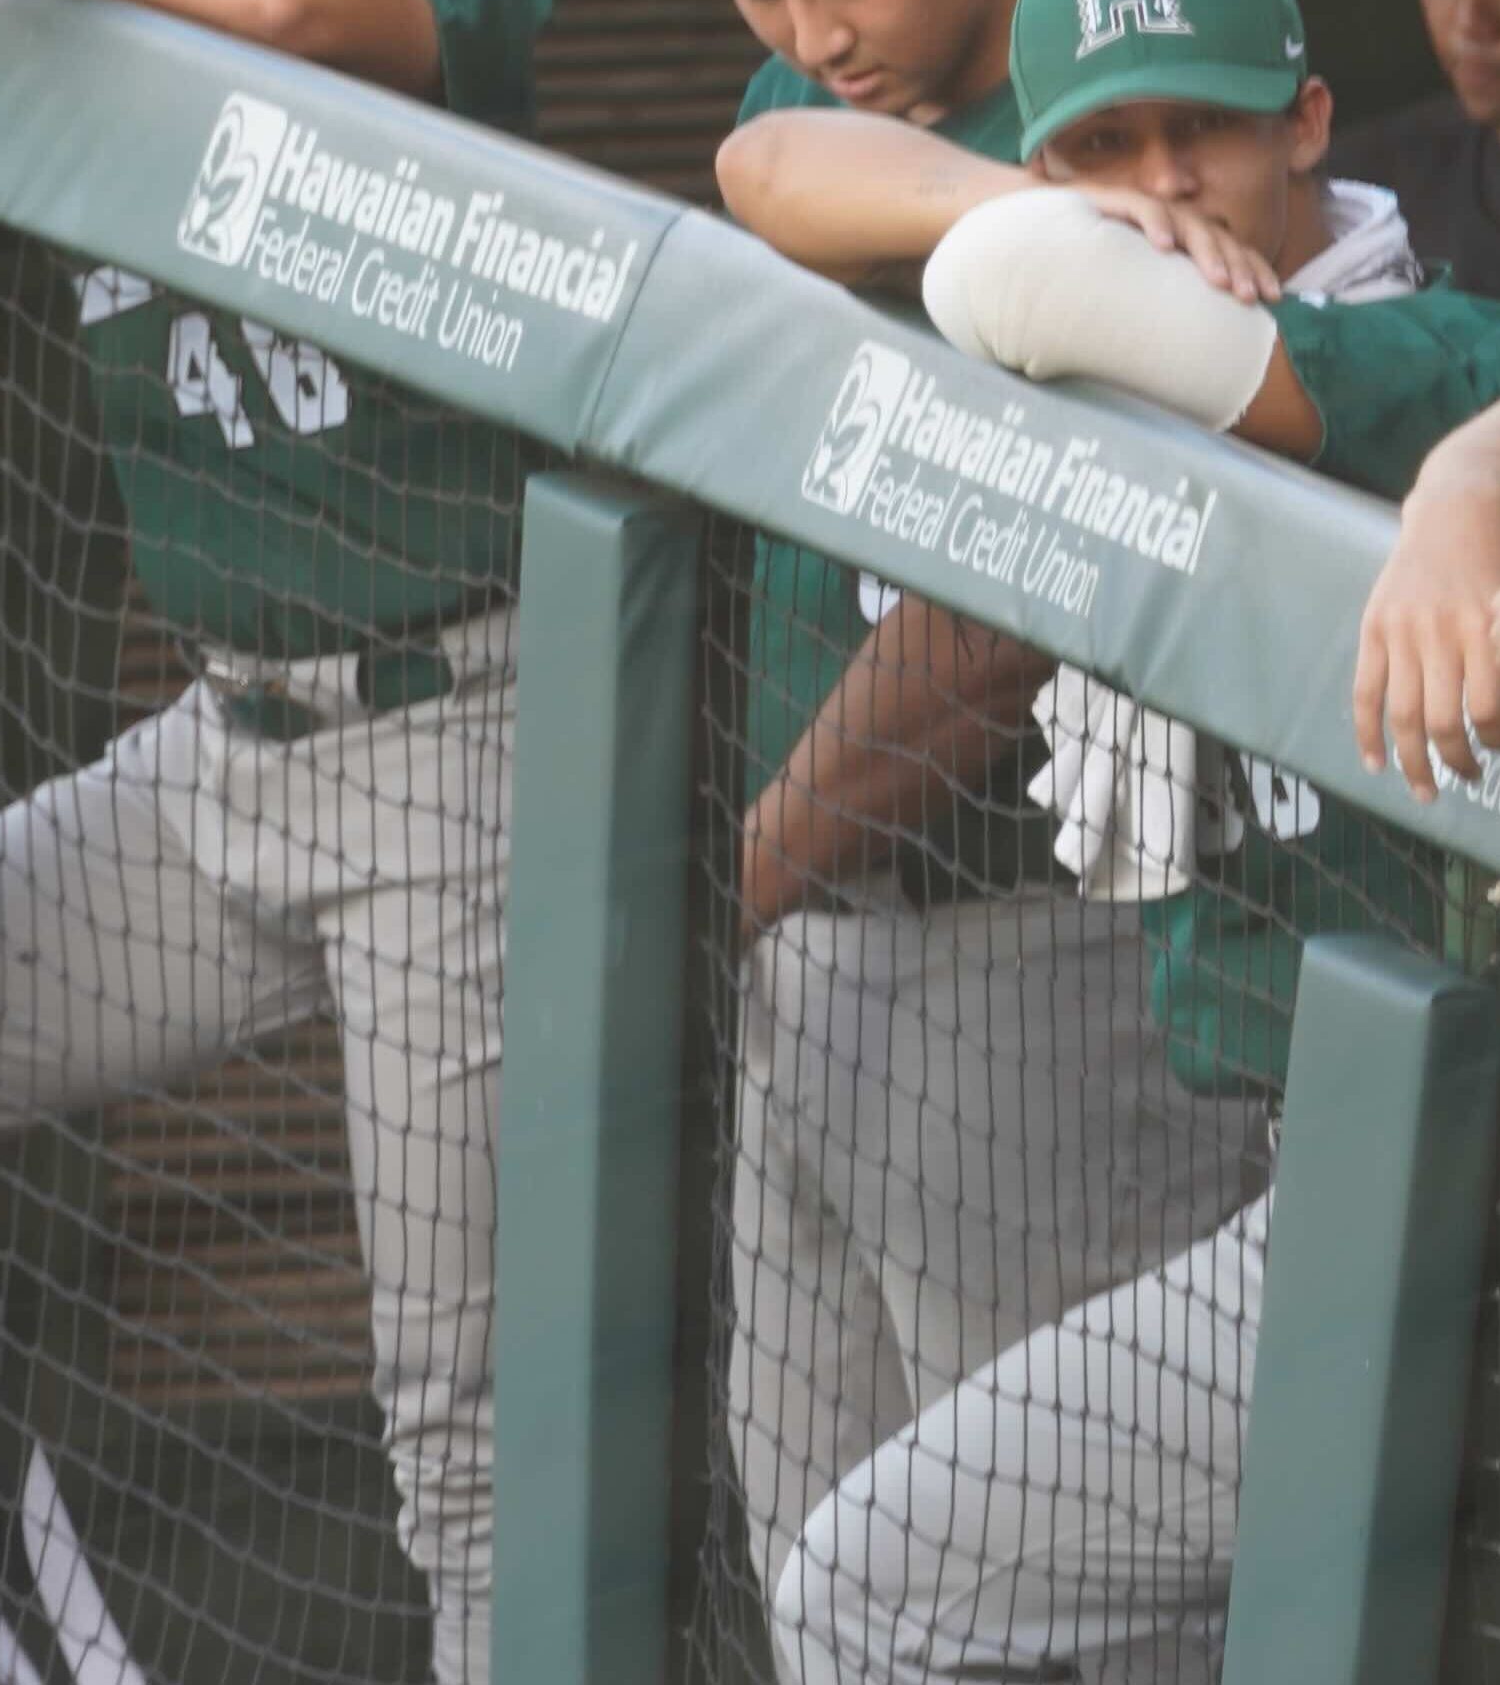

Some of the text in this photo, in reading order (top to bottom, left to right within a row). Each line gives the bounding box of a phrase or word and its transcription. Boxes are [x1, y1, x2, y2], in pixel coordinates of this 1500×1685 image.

[243, 206, 358, 304] Federal
[350, 247, 441, 340] Credit
[437, 278, 525, 373] Union
[268, 123, 639, 324] Hawaiian Financial
[856, 454, 1099, 619] Federal Credit Union
[886, 368, 1219, 575] Hawaiian Financial
